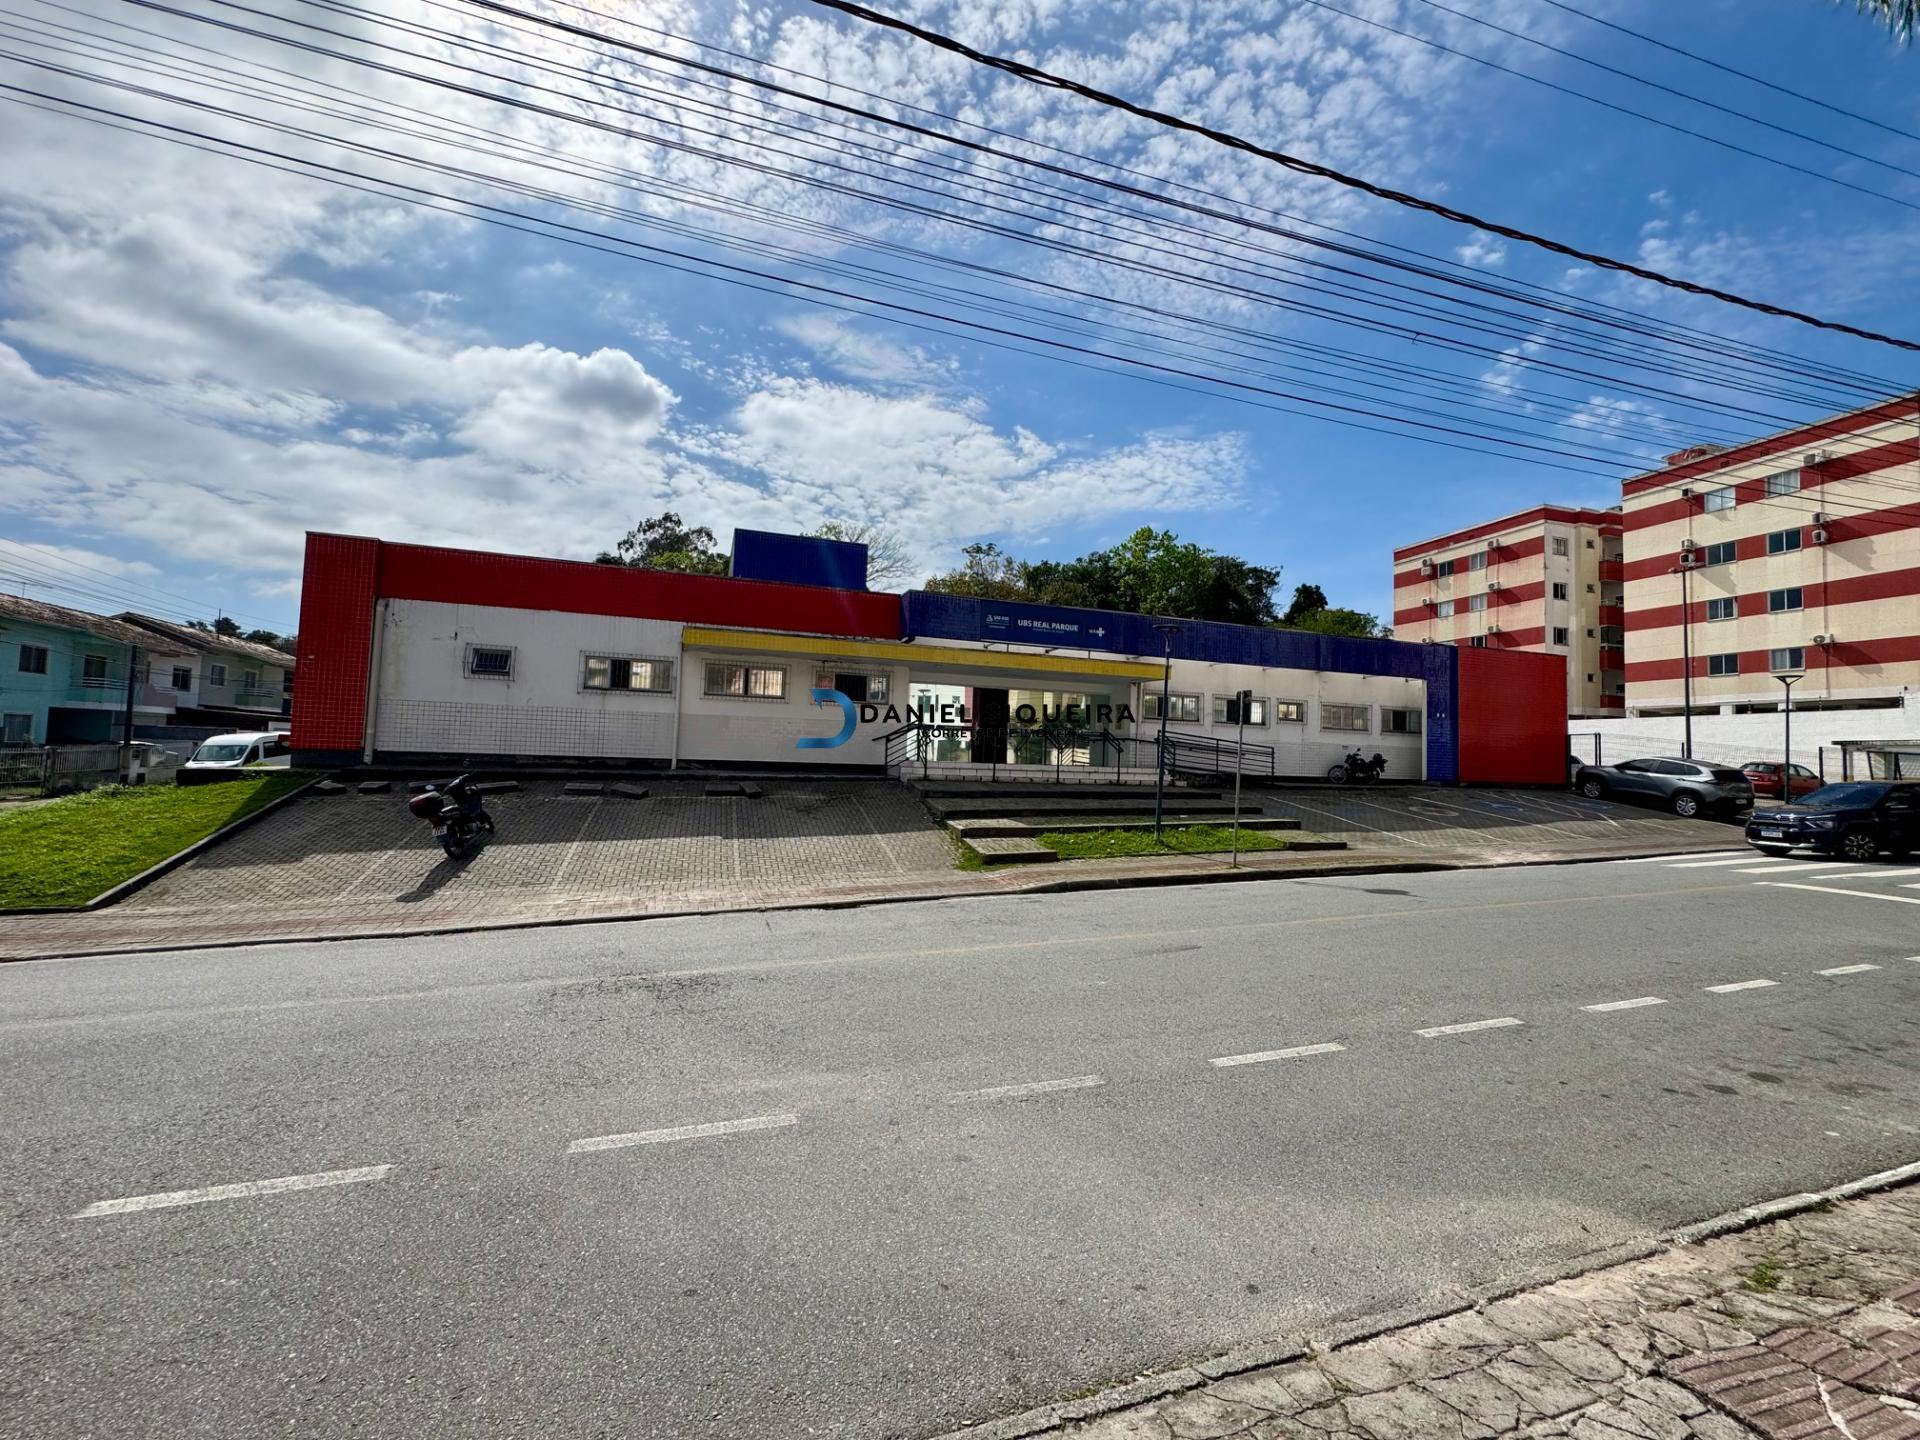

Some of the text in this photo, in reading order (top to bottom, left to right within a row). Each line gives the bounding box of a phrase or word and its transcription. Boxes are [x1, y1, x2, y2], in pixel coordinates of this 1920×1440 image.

[1018, 618, 1032, 627] UBS
[1033, 620, 1051, 629] REAL
[1051, 622, 1079, 632] PARQUE
